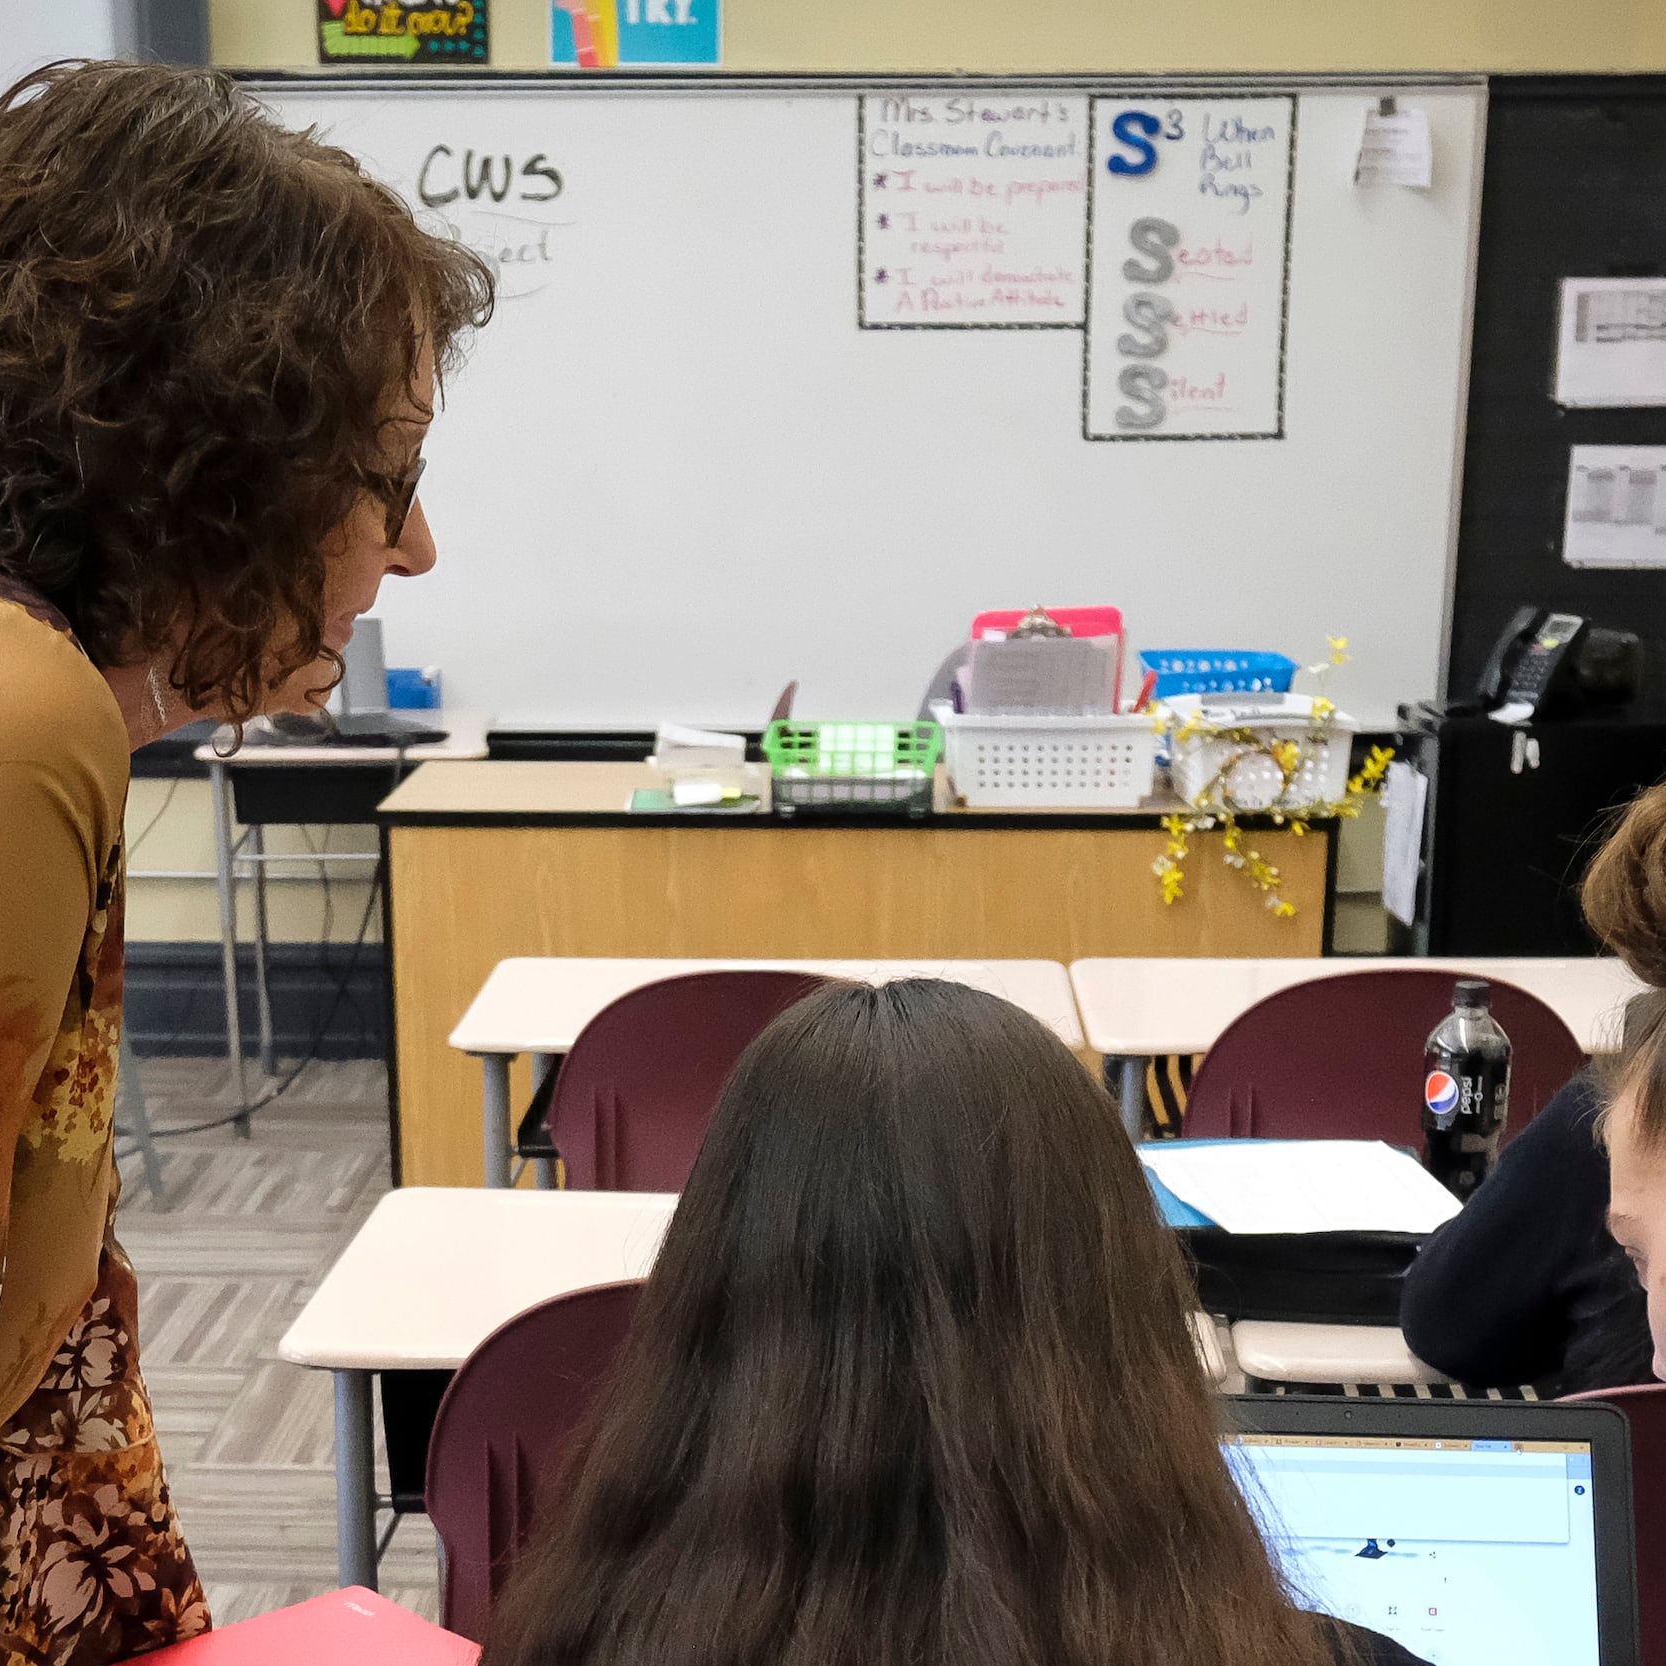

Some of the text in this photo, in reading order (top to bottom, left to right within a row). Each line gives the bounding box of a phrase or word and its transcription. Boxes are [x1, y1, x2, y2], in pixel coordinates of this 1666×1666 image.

[1200, 142, 1252, 171] Bell
[418, 143, 569, 209] CWS
[891, 168, 917, 192] I
[1461, 1076, 1474, 1115] pepsi
